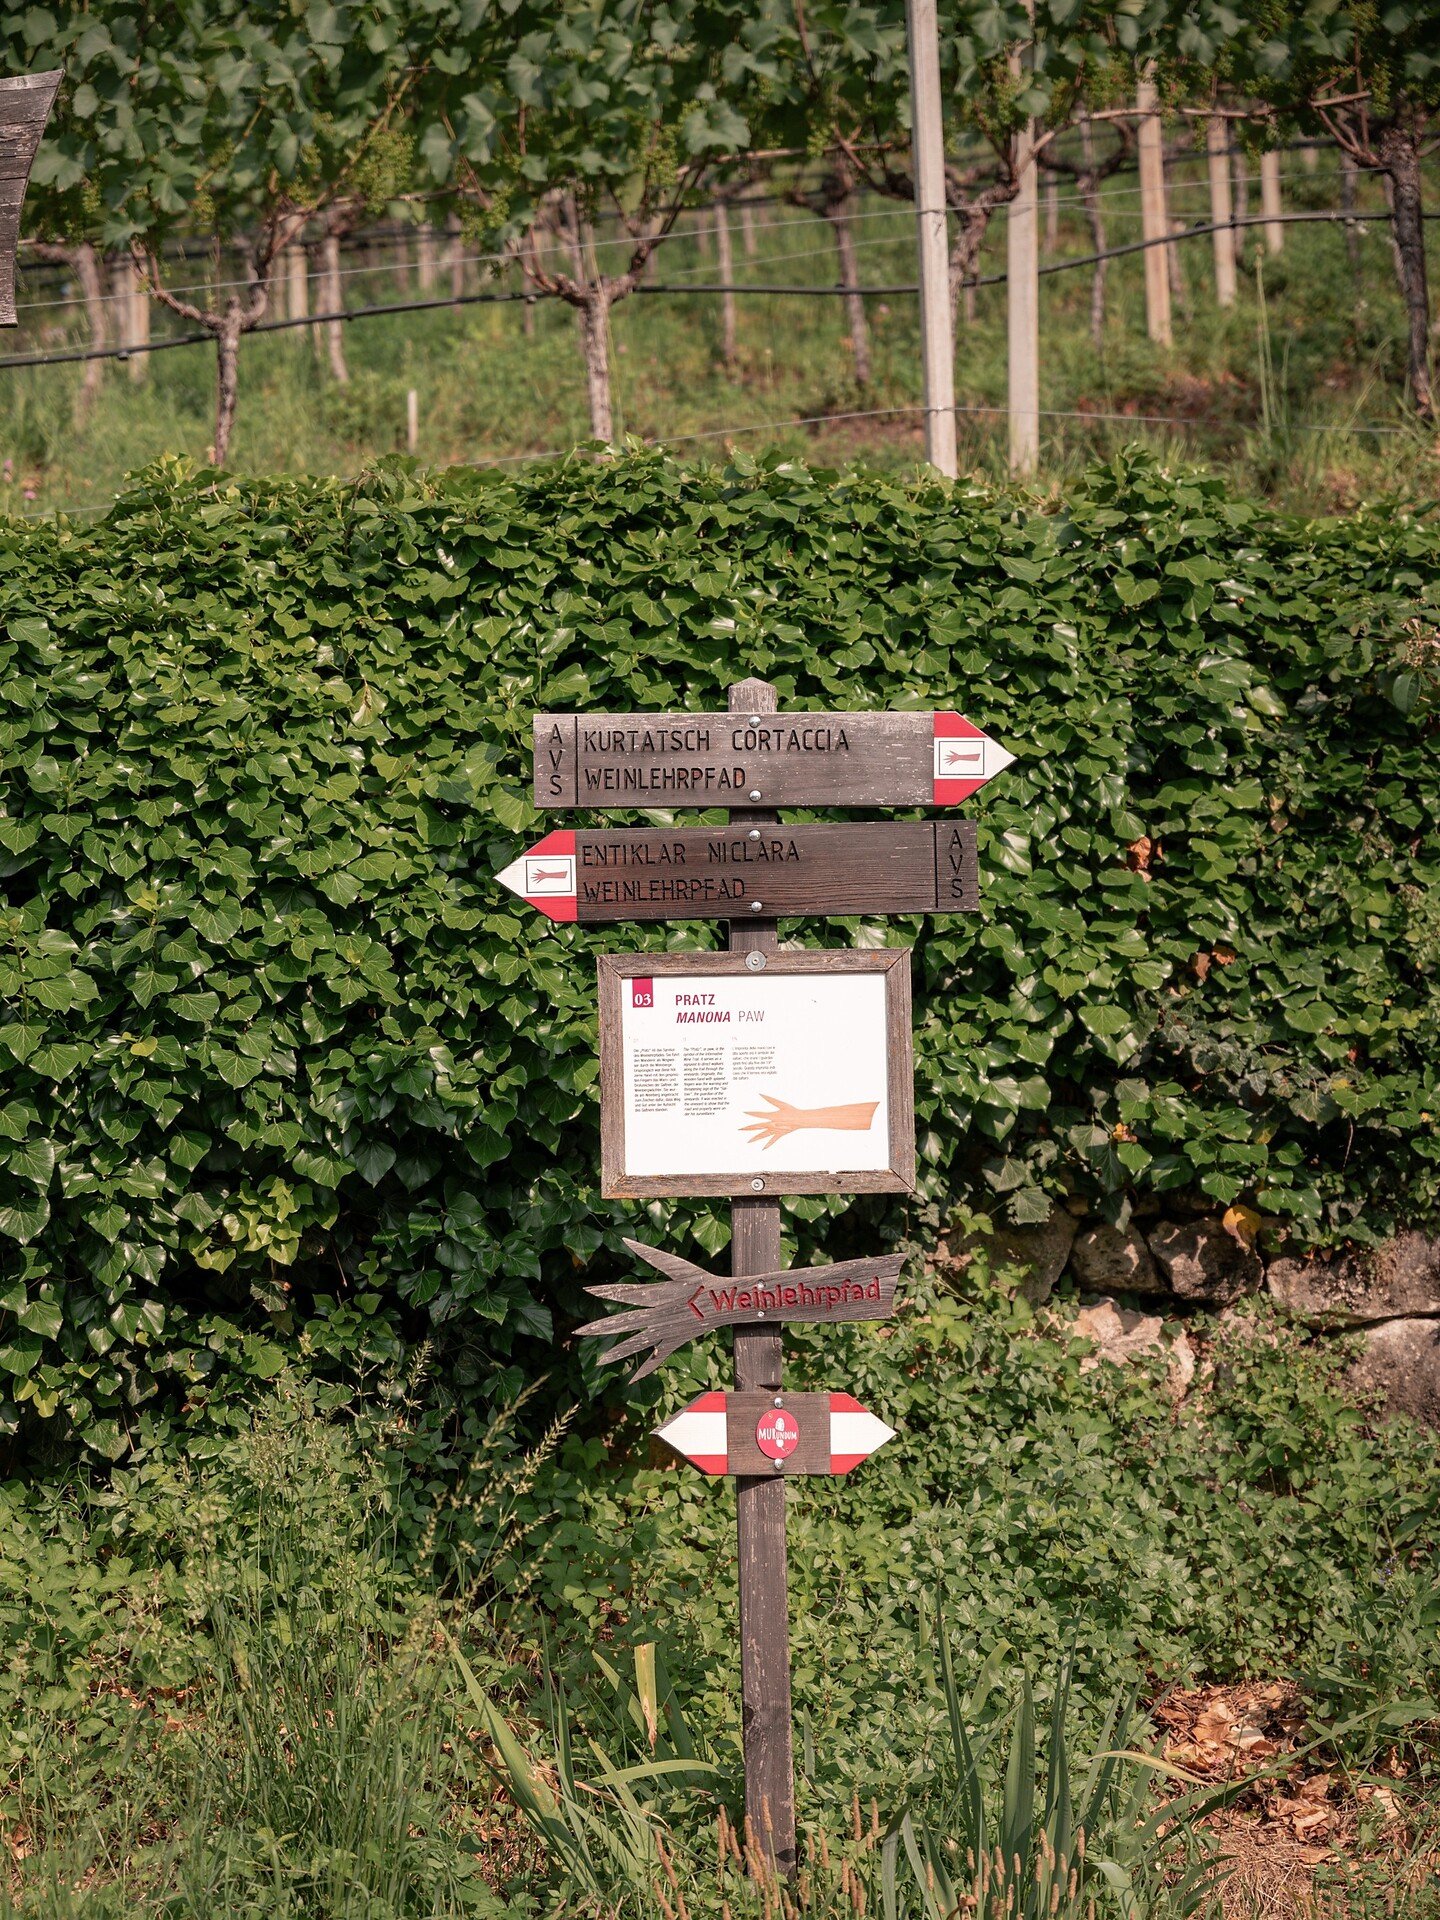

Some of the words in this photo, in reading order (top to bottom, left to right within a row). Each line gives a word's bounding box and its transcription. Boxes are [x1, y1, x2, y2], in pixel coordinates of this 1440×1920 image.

[584, 729, 710, 752] KURTATSCH
[731, 728, 850, 752] CORTACCIA
[585, 767, 747, 790] WEINLEHRPFAD
[582, 843, 686, 866] ENTIKLAR
[708, 840, 800, 864] NICLARA
[583, 878, 746, 902] WEINLEHRPFAD
[634, 993, 652, 1006] 03
[675, 994, 716, 1006] PRATZ
[676, 1010, 731, 1024] MANONA
[738, 1010, 765, 1022] PAW
[708, 1276, 881, 1312] Weinlehrpfad
